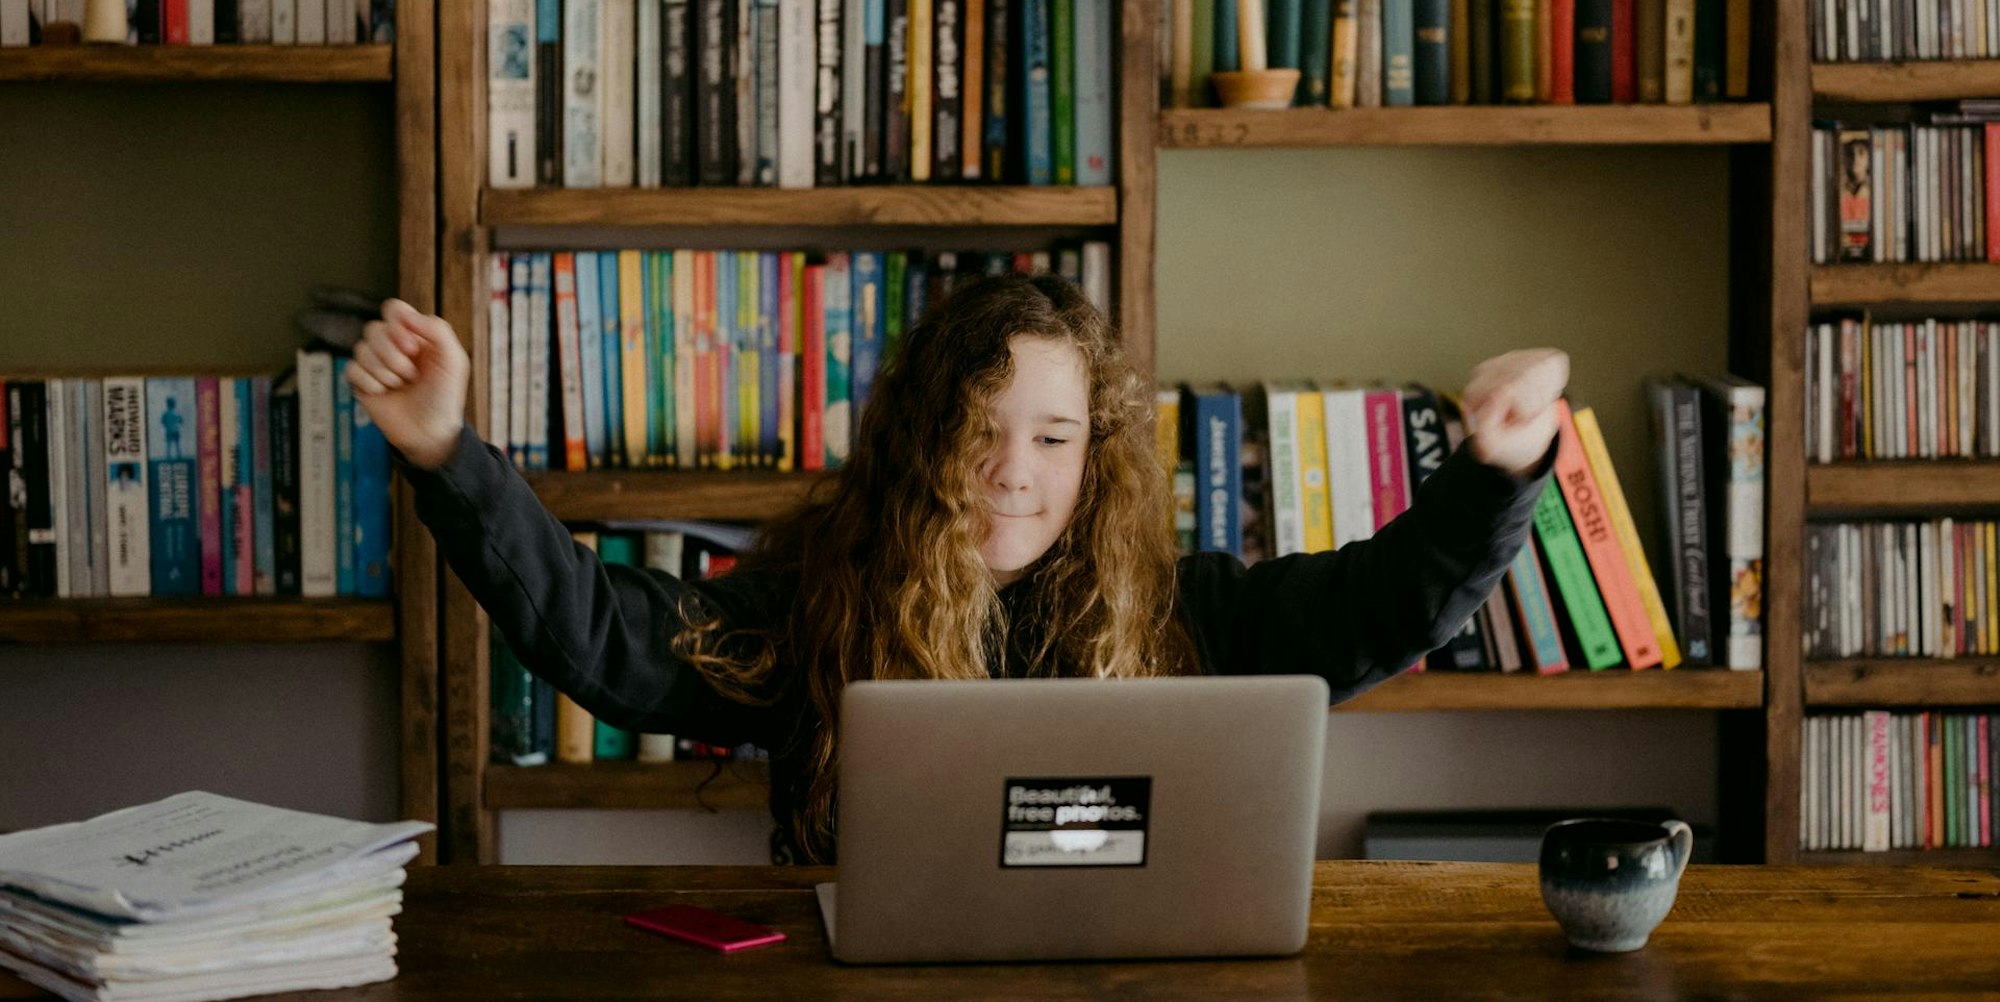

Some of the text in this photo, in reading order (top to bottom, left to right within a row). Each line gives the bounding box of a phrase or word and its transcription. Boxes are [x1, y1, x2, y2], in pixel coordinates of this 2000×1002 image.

[108, 386, 128, 457] MARKS
[1410, 408, 1442, 483] SAV
[1210, 488, 1228, 549] GREAT
[1567, 468, 1609, 544] BOSH!
[1009, 785, 1116, 806] Beautiful,
[1871, 711, 1890, 815] RAMONES
[1008, 804, 1143, 826] free photos.
